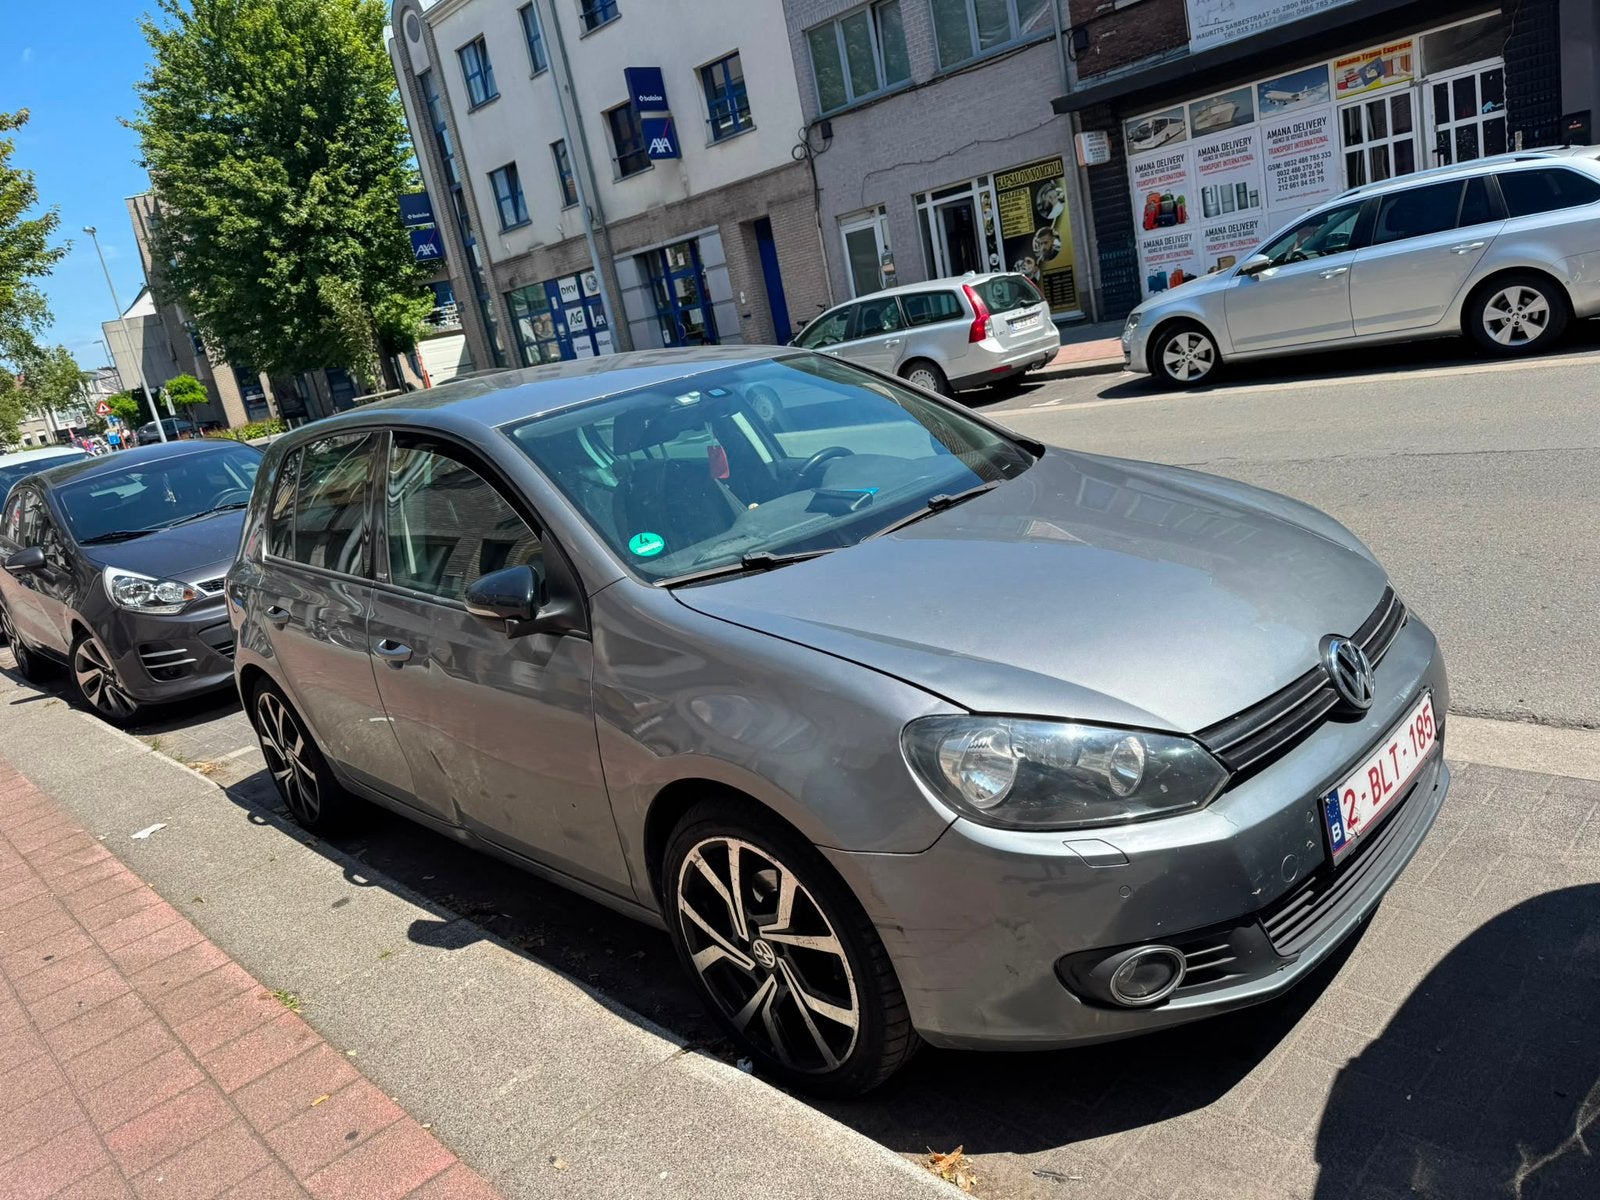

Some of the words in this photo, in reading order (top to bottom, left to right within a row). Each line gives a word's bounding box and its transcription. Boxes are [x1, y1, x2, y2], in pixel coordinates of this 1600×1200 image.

[1196, 27, 1224, 40] MAURITS
[1225, 11, 1270, 31] SABBESTRAAT
[1281, 2, 1299, 12] 2800
[1236, 25, 1249, 35] 015
[1250, 22, 1262, 31] 711
[1336, 56, 1361, 68] Amana
[1383, 41, 1412, 55] Express
[644, 94, 662, 102] baloise
[1267, 126, 1292, 140] AMANA
[1293, 116, 1326, 134] DELIVERY
[648, 138, 673, 154] AXA
[1198, 145, 1220, 158] AMANA
[1221, 136, 1252, 151] DELIVERY
[1268, 143, 1294, 155] TRANSPORT
[1294, 135, 1328, 150] INTERNATIONAL
[1134, 162, 1155, 174] AMANA
[1156, 154, 1185, 169] DELIVERY
[1199, 160, 1222, 172] TRANSPORT
[1222, 154, 1254, 166] INTERNATIONAL
[1267, 163, 1282, 171] GSM:
[1284, 158, 1297, 168] 0032
[1298, 156, 1308, 164] 486
[1310, 154, 1320, 162] 785
[1321, 150, 1332, 159] 333
[1276, 168, 1290, 177] 0032
[1291, 166, 1301, 174] 486
[1302, 164, 1312, 172] 370
[1136, 176, 1157, 188] TRANSPORT
[1158, 170, 1186, 184] INTERNATIONAL
[1278, 176, 1288, 184] 212
[1288, 174, 1298, 182] 630
[1278, 183, 1288, 191] 212
[1204, 228, 1227, 237] AMANA
[1228, 220, 1259, 235] DELIVERY
[1143, 239, 1164, 249] AMANA
[1164, 233, 1193, 246] DELIVERY
[1206, 242, 1230, 251] TRANSPORT
[1230, 237, 1260, 248] INTERNATIONAL
[416, 244, 438, 257] AXA
[1144, 253, 1166, 262] TRANSPORT
[1166, 249, 1194, 260] INTERNATIONAL
[561, 284, 576, 295] DKV
[570, 310, 582, 325] AG
[1343, 703, 1433, 830] 2-BLT-185
[1332, 822, 1341, 842] B
